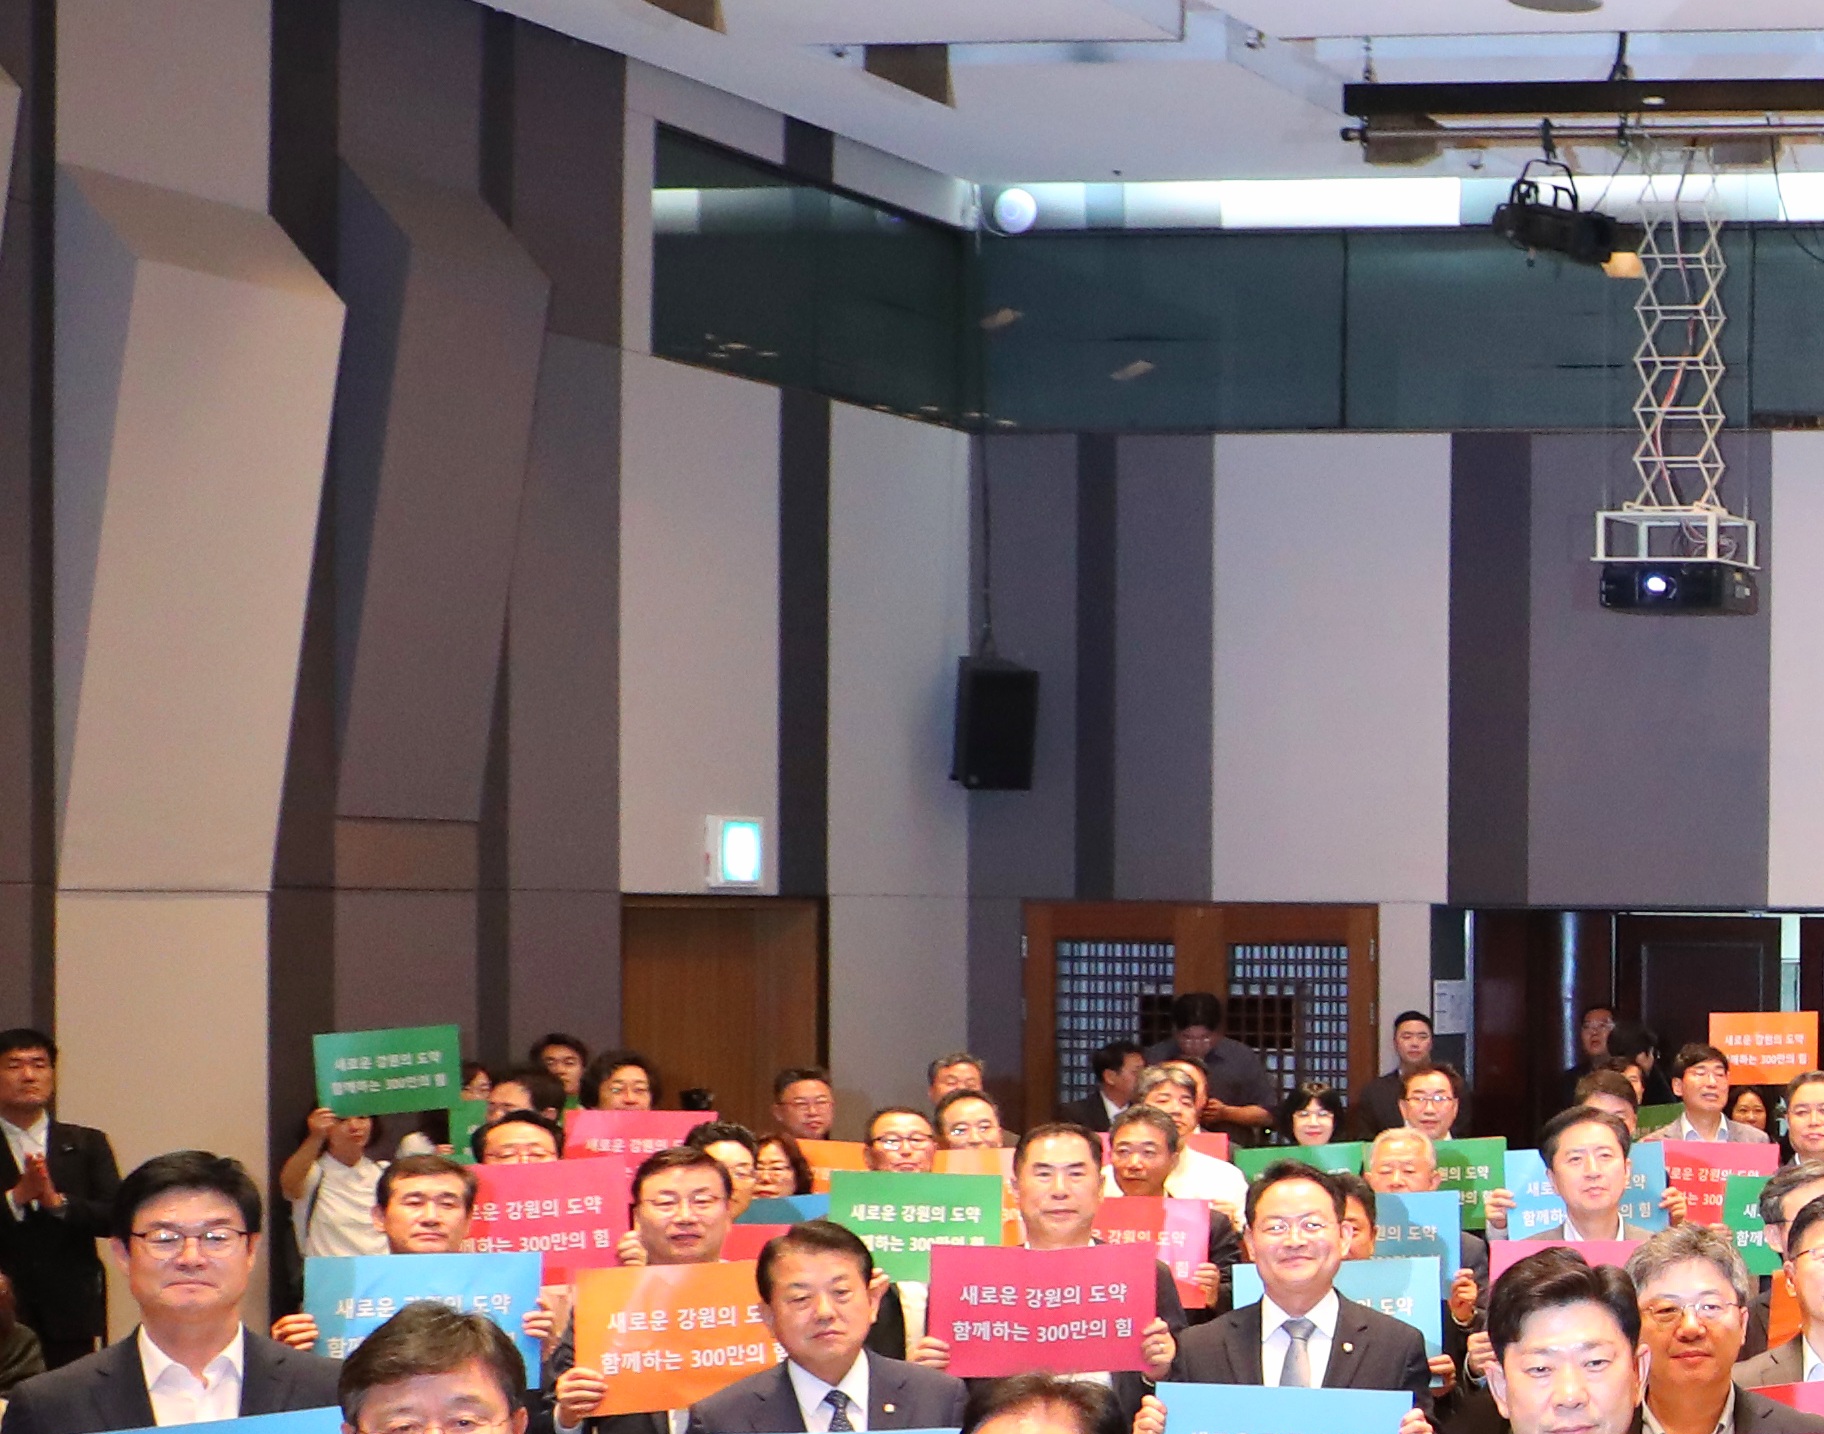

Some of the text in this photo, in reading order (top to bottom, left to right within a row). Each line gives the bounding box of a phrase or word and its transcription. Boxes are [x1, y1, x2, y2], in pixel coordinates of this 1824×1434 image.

[960, 1284, 1126, 1308] 새로운 강원의 도약
[952, 1318, 1132, 1342] 함께하는 300만의 힘
